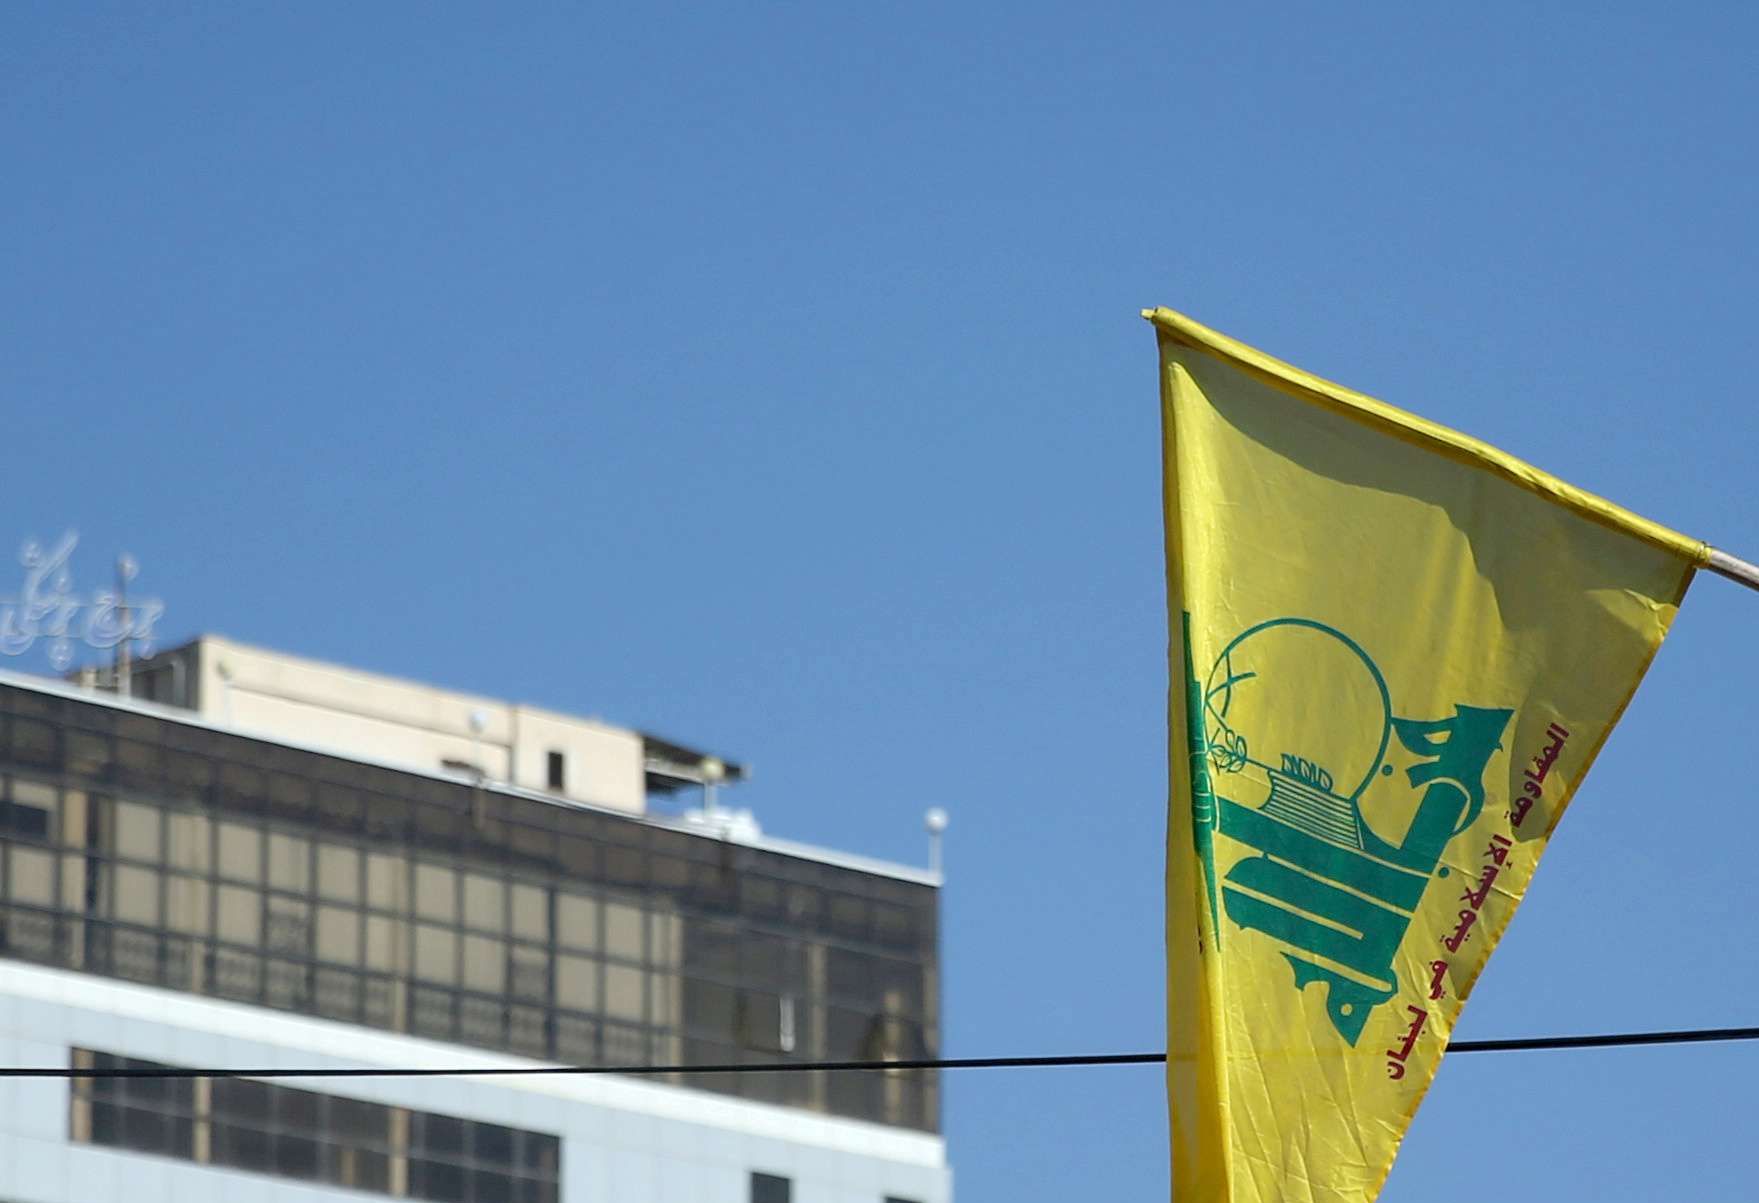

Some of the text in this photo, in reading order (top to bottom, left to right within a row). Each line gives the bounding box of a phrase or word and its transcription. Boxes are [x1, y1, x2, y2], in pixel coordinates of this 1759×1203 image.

[1504, 722, 1570, 828] المقاومة
[1428, 959, 1448, 1000] في
[1386, 1004, 1429, 1081] لبنان
